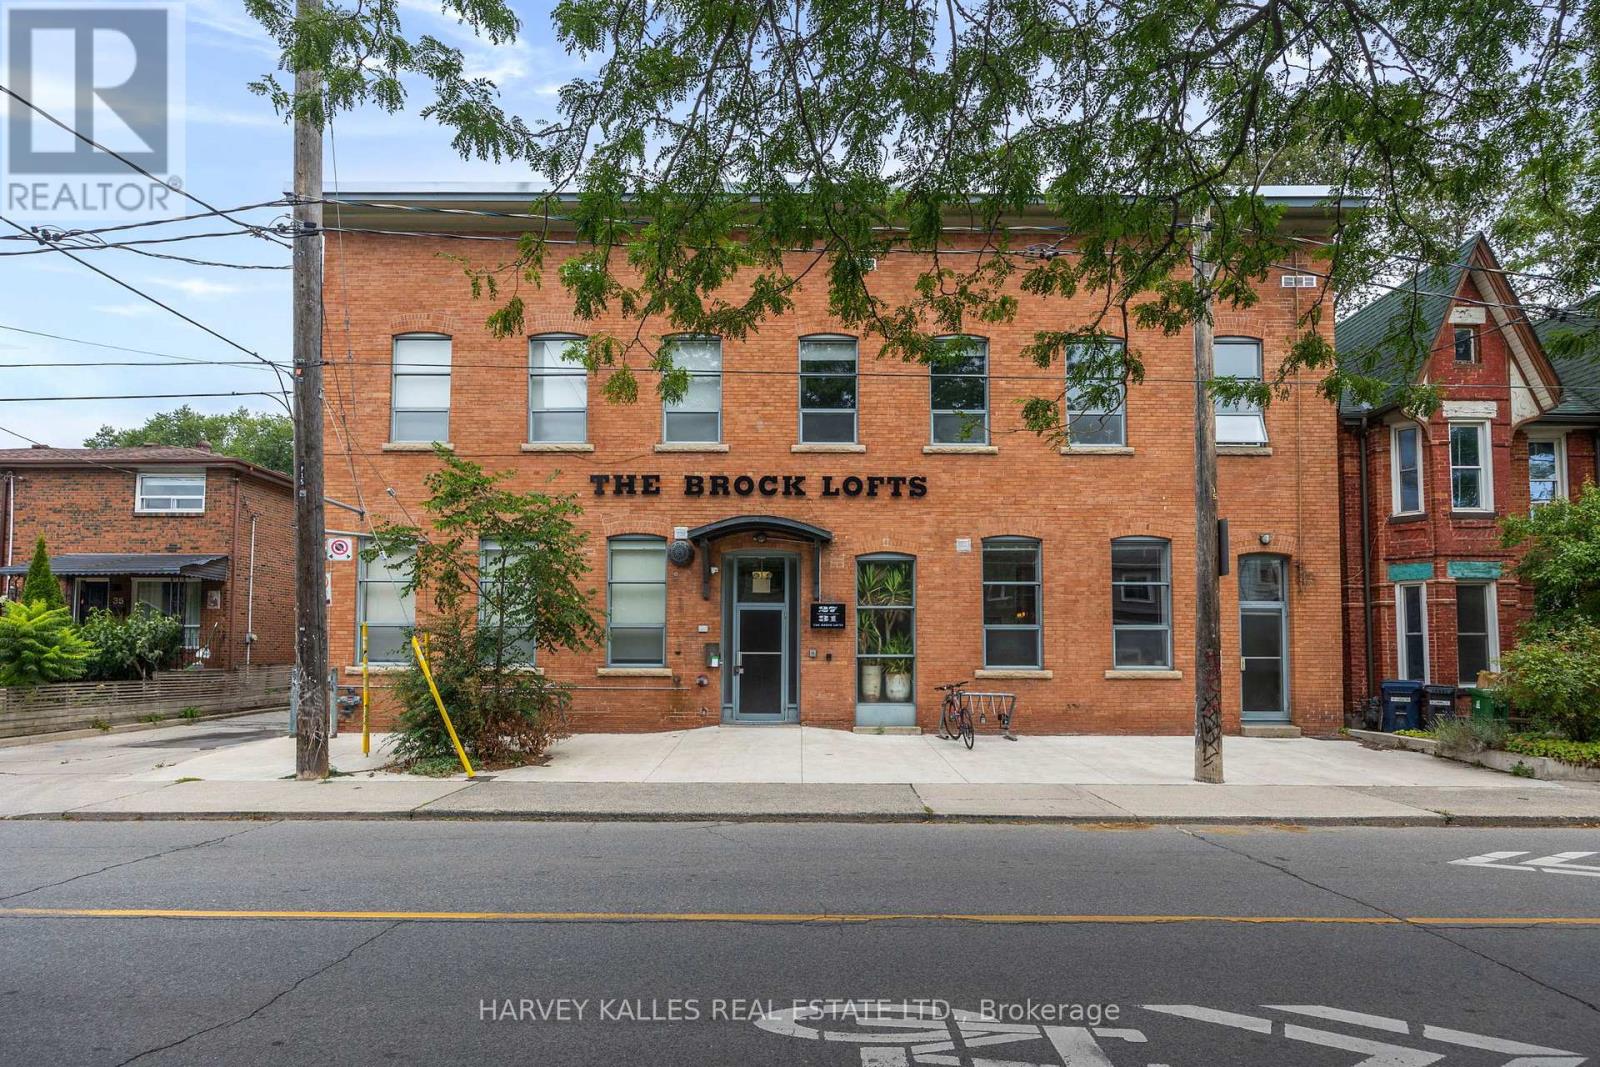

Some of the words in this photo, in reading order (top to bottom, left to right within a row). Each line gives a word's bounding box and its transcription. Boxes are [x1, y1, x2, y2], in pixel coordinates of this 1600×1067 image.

[590, 475, 661, 496] THE
[684, 476, 807, 496] BROCK
[822, 476, 928, 497] LOFTS
